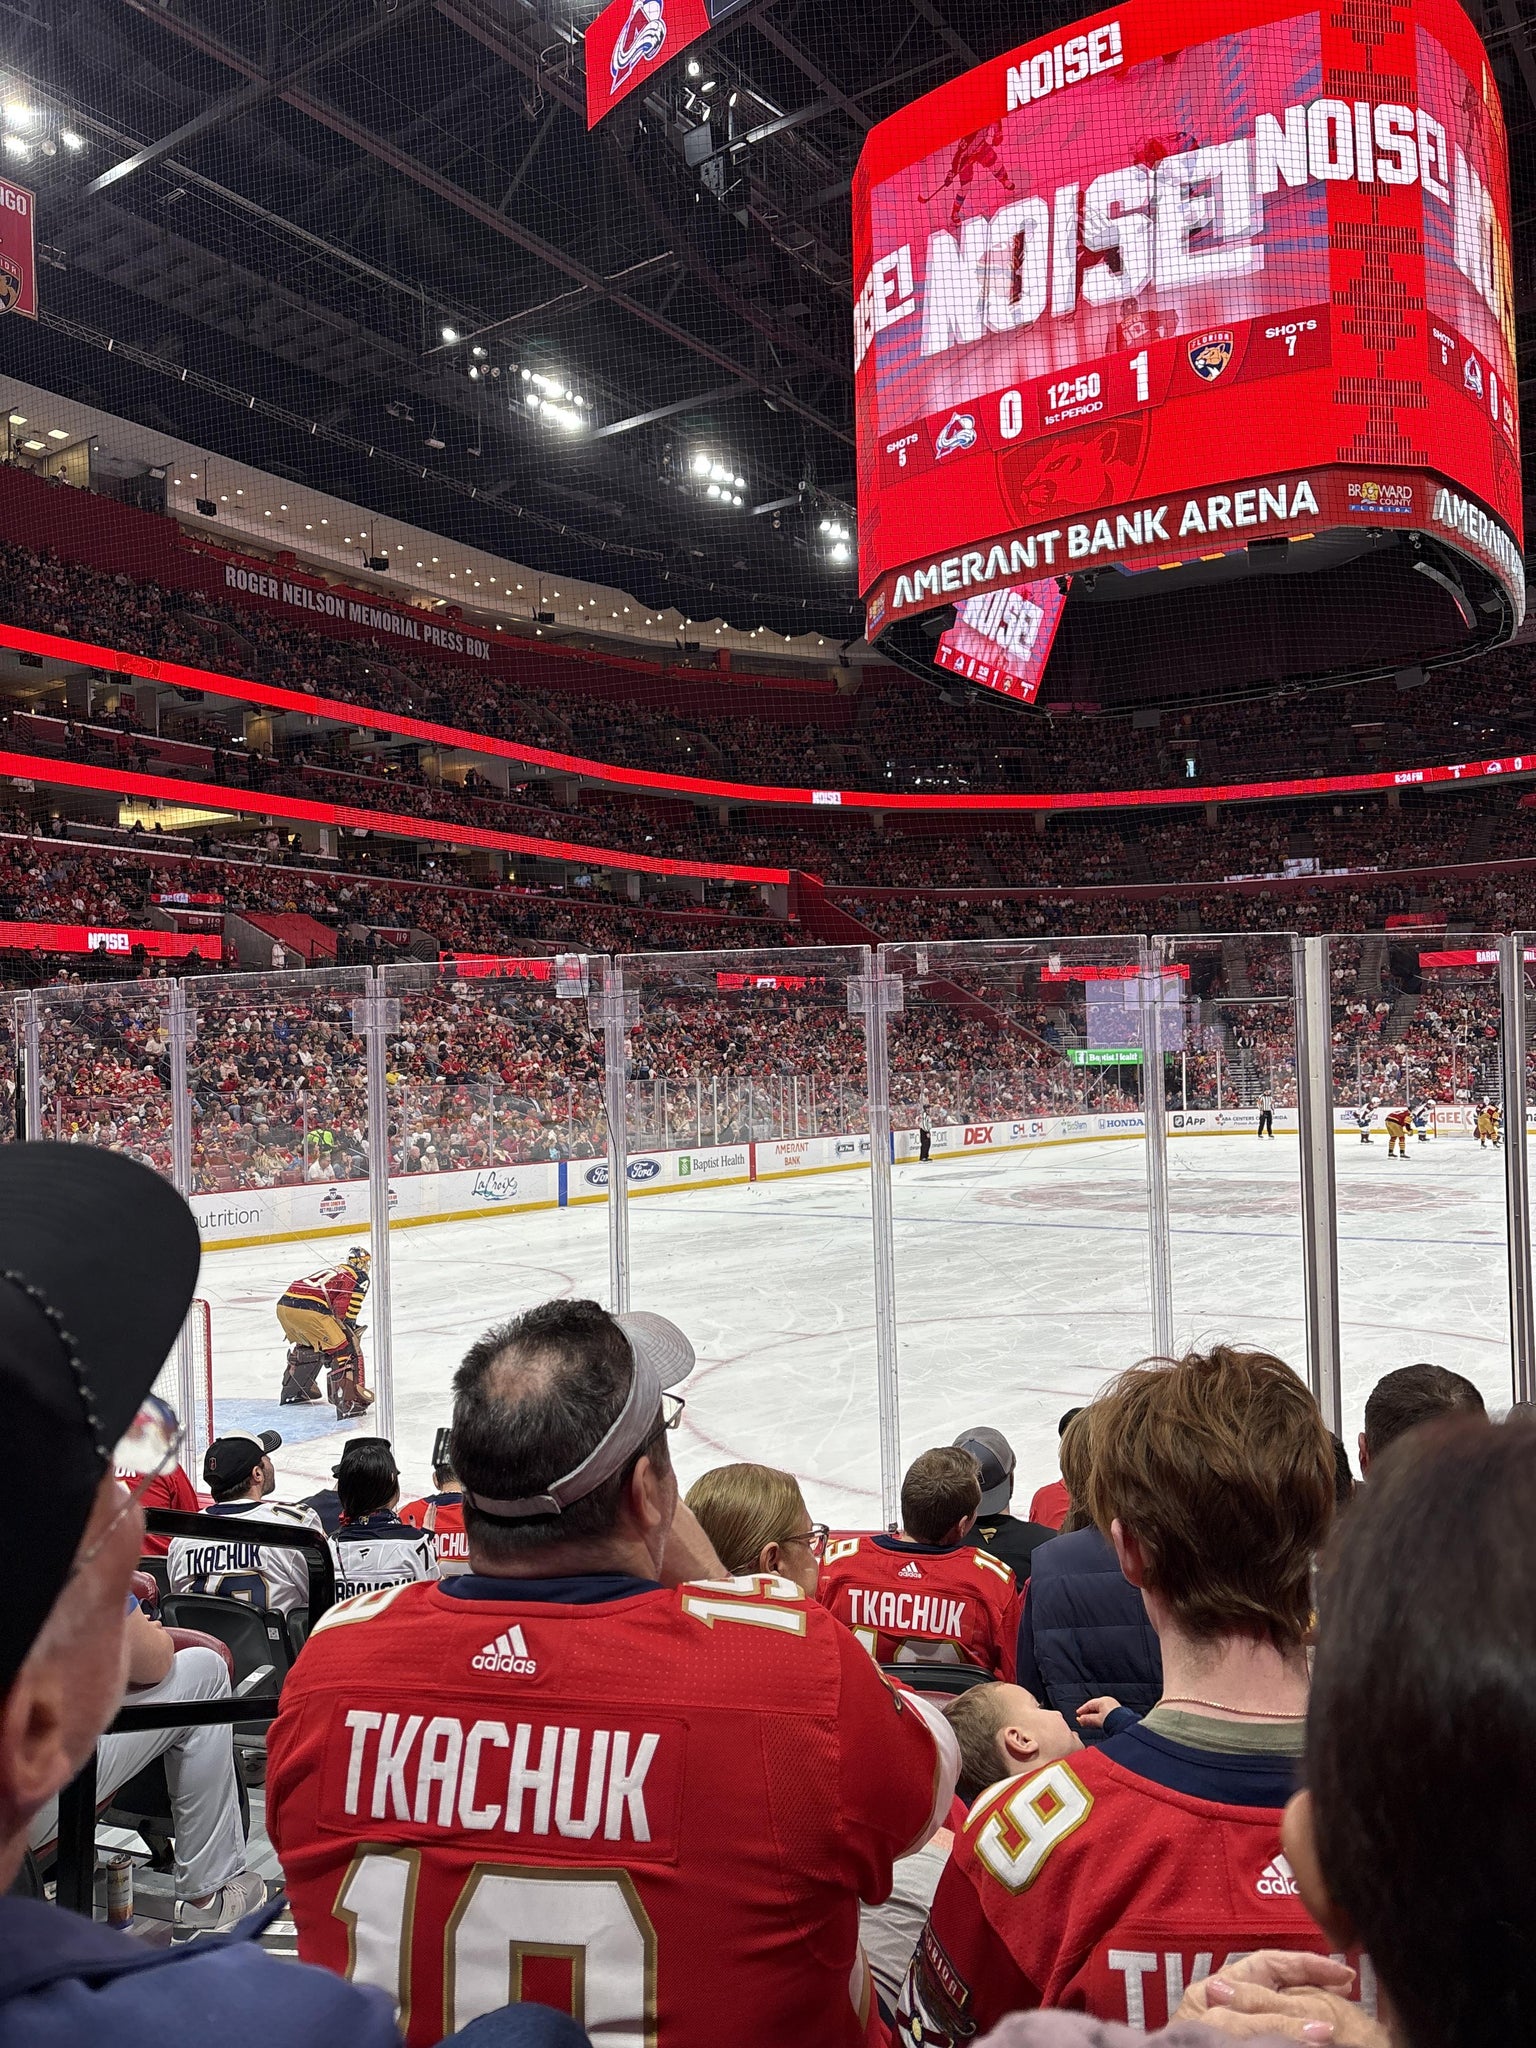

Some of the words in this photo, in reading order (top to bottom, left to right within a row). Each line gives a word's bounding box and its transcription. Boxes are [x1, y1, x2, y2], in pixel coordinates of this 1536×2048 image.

[1006, 20, 1124, 112] NOISE!
[1255, 98, 1450, 206] NOISE!
[920, 137, 1265, 357] NOISE!
[1191, 333, 1230, 348] FLORIDA
[1264, 319, 1318, 339] SHOTS
[1432, 327, 1455, 350] SHOTS
[1284, 335, 1297, 357] 7
[1129, 350, 1149, 402] 1
[1047, 372, 1101, 410] 12:50
[1000, 390, 1023, 440] 0
[1044, 413, 1060, 425] 1st
[1061, 401, 1103, 420] PERIOD
[886, 433, 919, 453] SHOTS
[898, 448, 907, 467] 5
[1379, 498, 1412, 506] COUNTY
[892, 529, 1062, 608] AMERANT
[1068, 505, 1170, 560] BANK
[1178, 480, 1320, 537] ARENA
[225, 565, 279, 600] ROGER
[282, 581, 346, 619] NEILSON
[349, 602, 422, 642] MEMORIAL
[423, 625, 464, 654] PRESS
[466, 638, 491, 661] BOX
[1106, 1118, 1145, 1128] HONDA
[963, 1126, 994, 1146] DEX
[775, 1142, 809, 1155] AMERANT
[631, 1162, 654, 1178] Ford
[693, 1157, 719, 1172] Baptist
[721, 1153, 745, 1167] Health
[784, 1156, 801, 1166] BANK
[185, 1542, 262, 1576] TKACHUK
[848, 1588, 966, 1638] TKACHUK
[471, 1652, 537, 1675] adidas
[344, 1709, 661, 1842] TKACHUK
